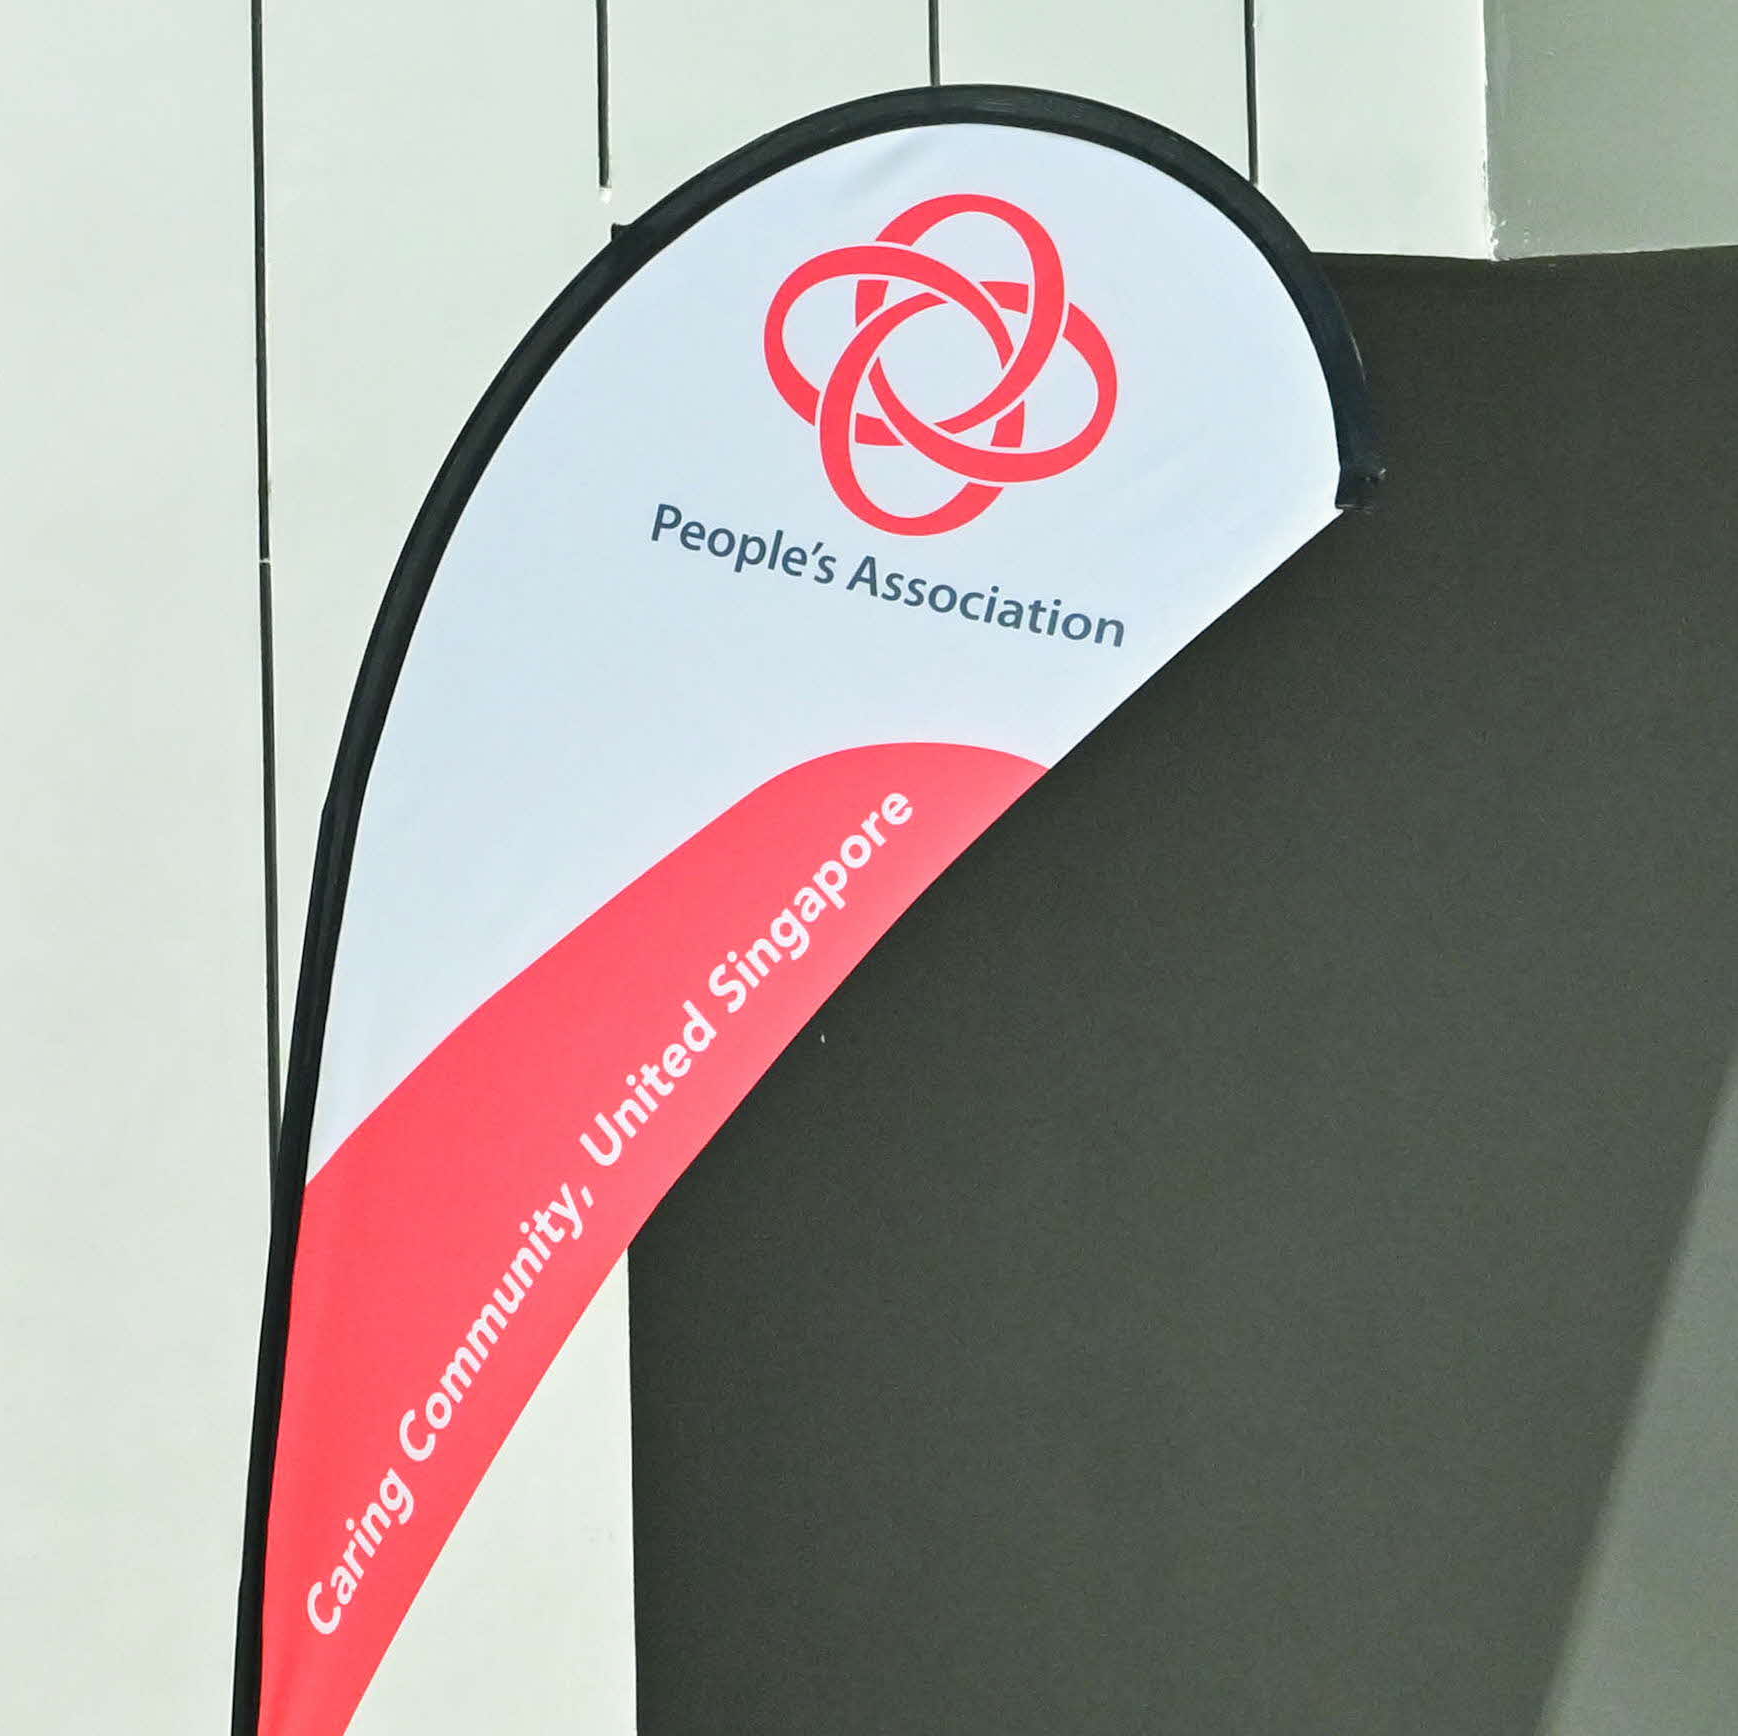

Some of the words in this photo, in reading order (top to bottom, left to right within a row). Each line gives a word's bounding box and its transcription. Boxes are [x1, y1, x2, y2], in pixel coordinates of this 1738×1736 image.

[649, 502, 837, 585] People's
[844, 553, 1128, 649] Association
[305, 1466, 416, 1637] Caring
[396, 1181, 597, 1465] Community,
[579, 1000, 722, 1169] United
[706, 789, 917, 1015] Singapore
